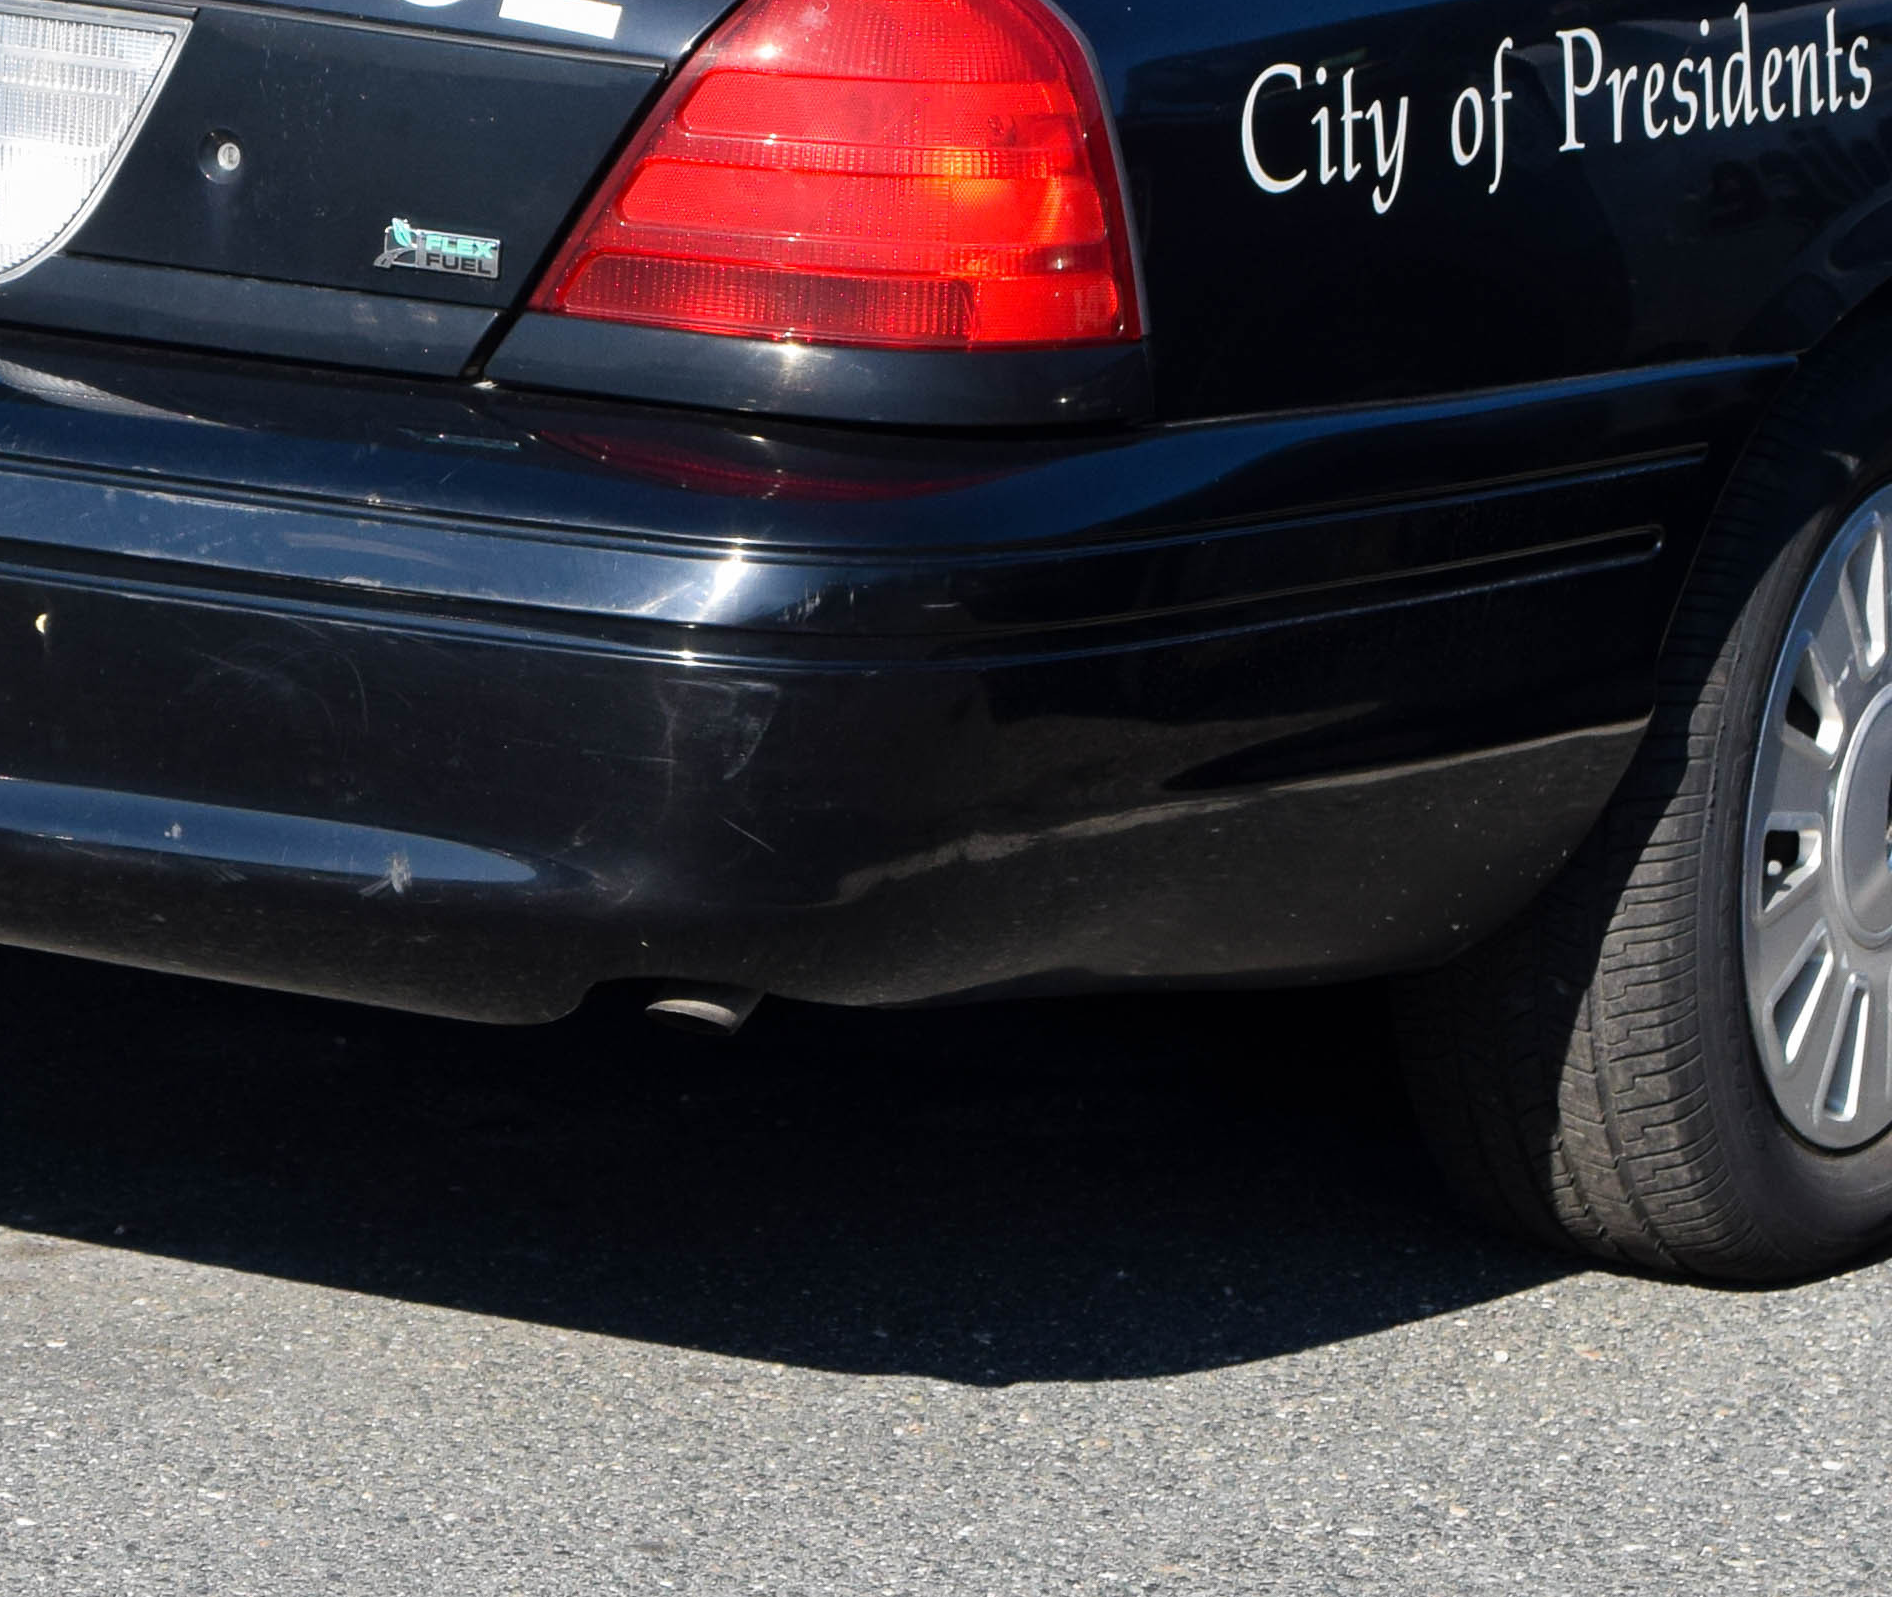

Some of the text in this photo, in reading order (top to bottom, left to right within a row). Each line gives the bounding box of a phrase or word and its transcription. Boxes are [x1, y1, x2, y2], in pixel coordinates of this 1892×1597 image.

[1241, 63, 1410, 214] City
[1450, 37, 1514, 195] of
[1556, 2, 1873, 153] Presidents
[425, 234, 493, 259] FLEX
[426, 253, 492, 274] FUEL
